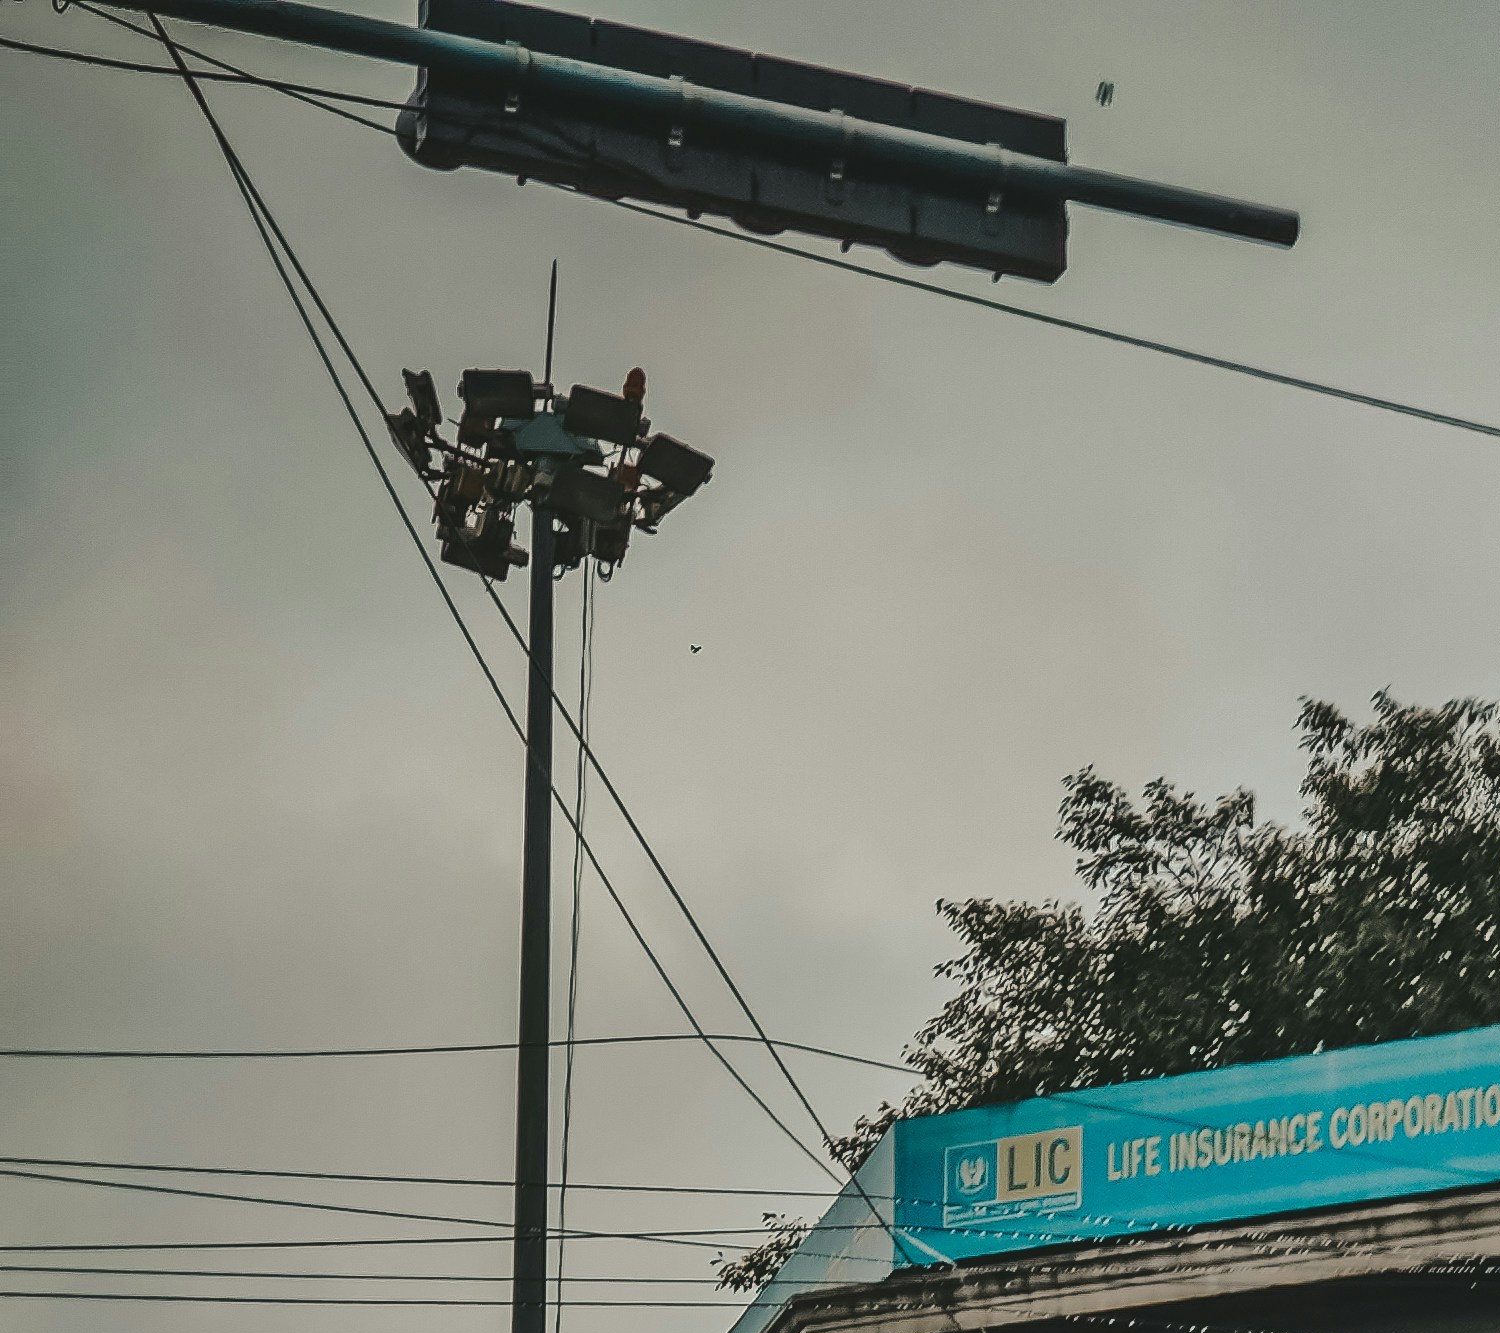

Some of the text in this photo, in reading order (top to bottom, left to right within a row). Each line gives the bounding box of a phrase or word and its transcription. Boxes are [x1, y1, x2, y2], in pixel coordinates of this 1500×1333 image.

[1007, 1136, 1072, 1191] LIC
[1106, 1134, 1162, 1183] LIFE
[1169, 1110, 1322, 1174] INSURANCE
